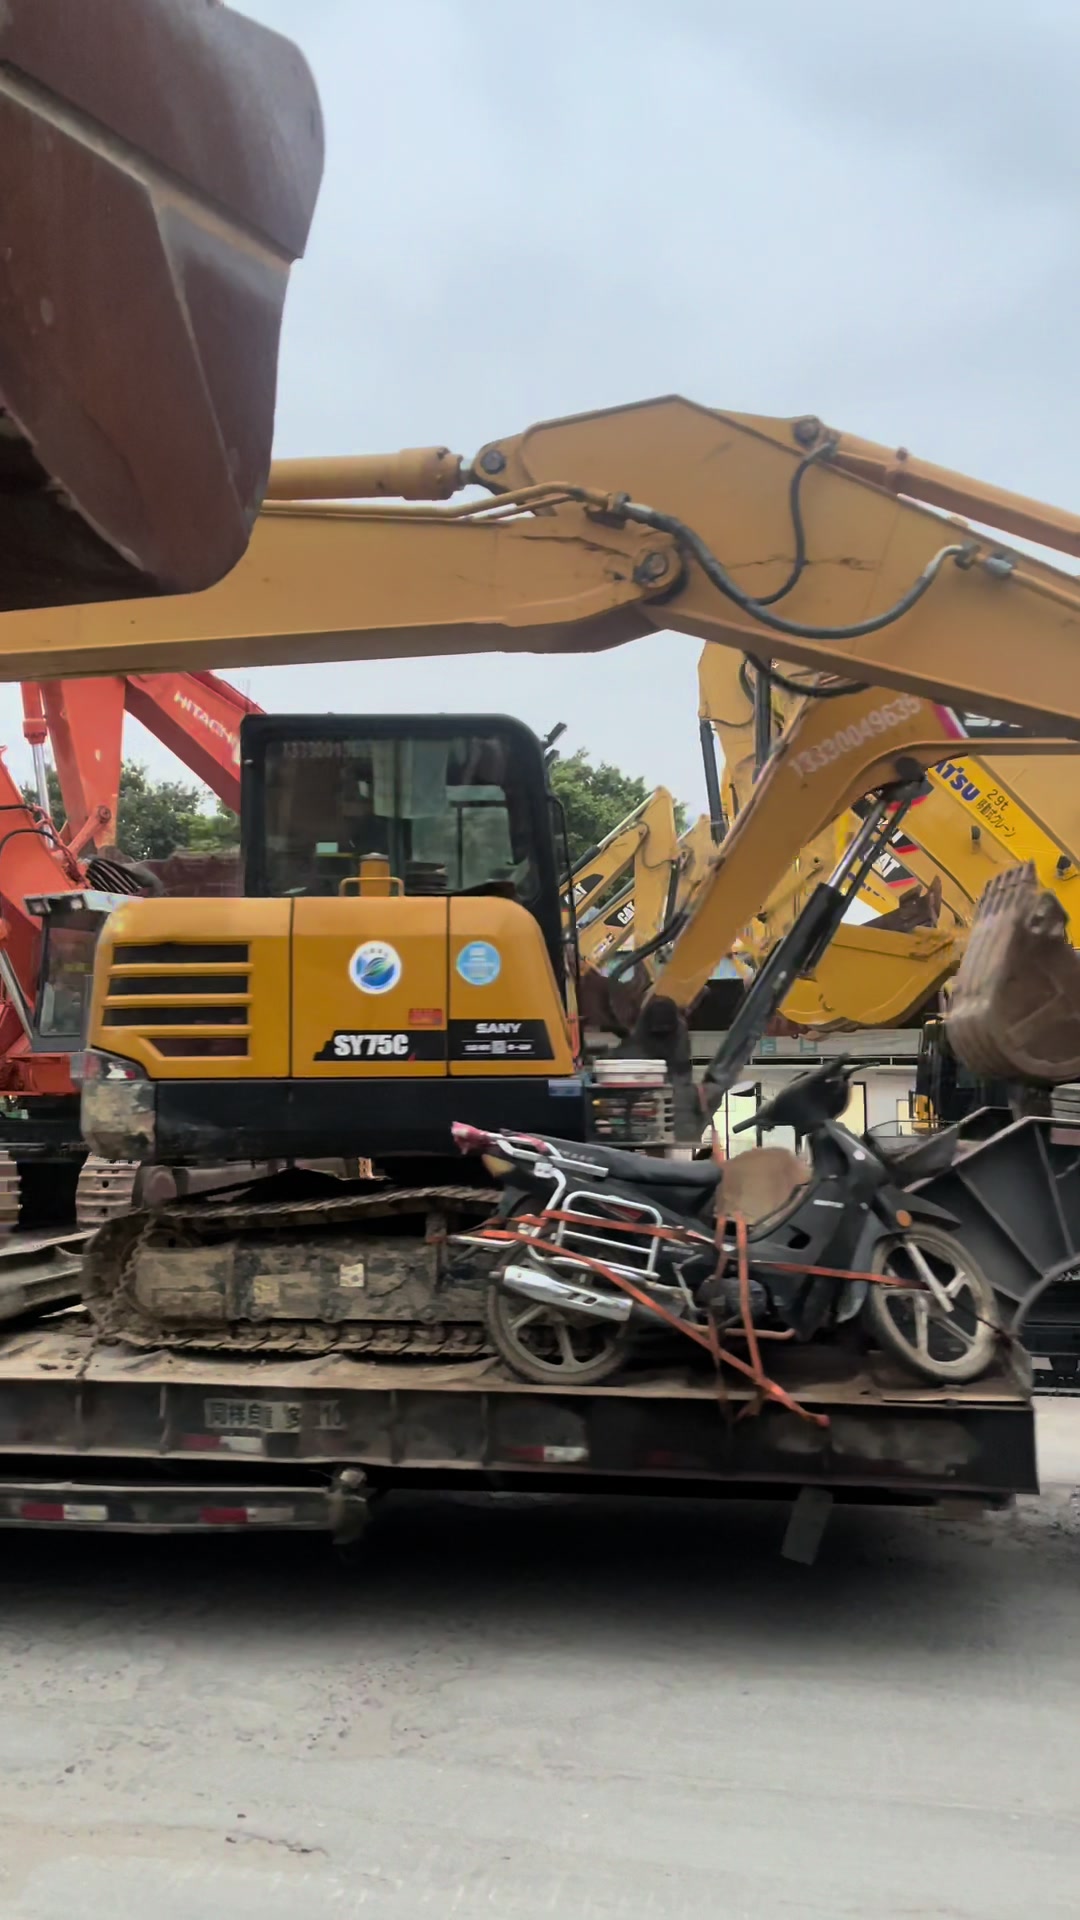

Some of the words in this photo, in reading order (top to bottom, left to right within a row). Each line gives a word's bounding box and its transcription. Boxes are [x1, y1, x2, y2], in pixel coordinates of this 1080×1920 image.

[935, 760, 981, 801] ATSU
[475, 1023, 523, 1034] SANY
[333, 1034, 409, 1056] SY75C
